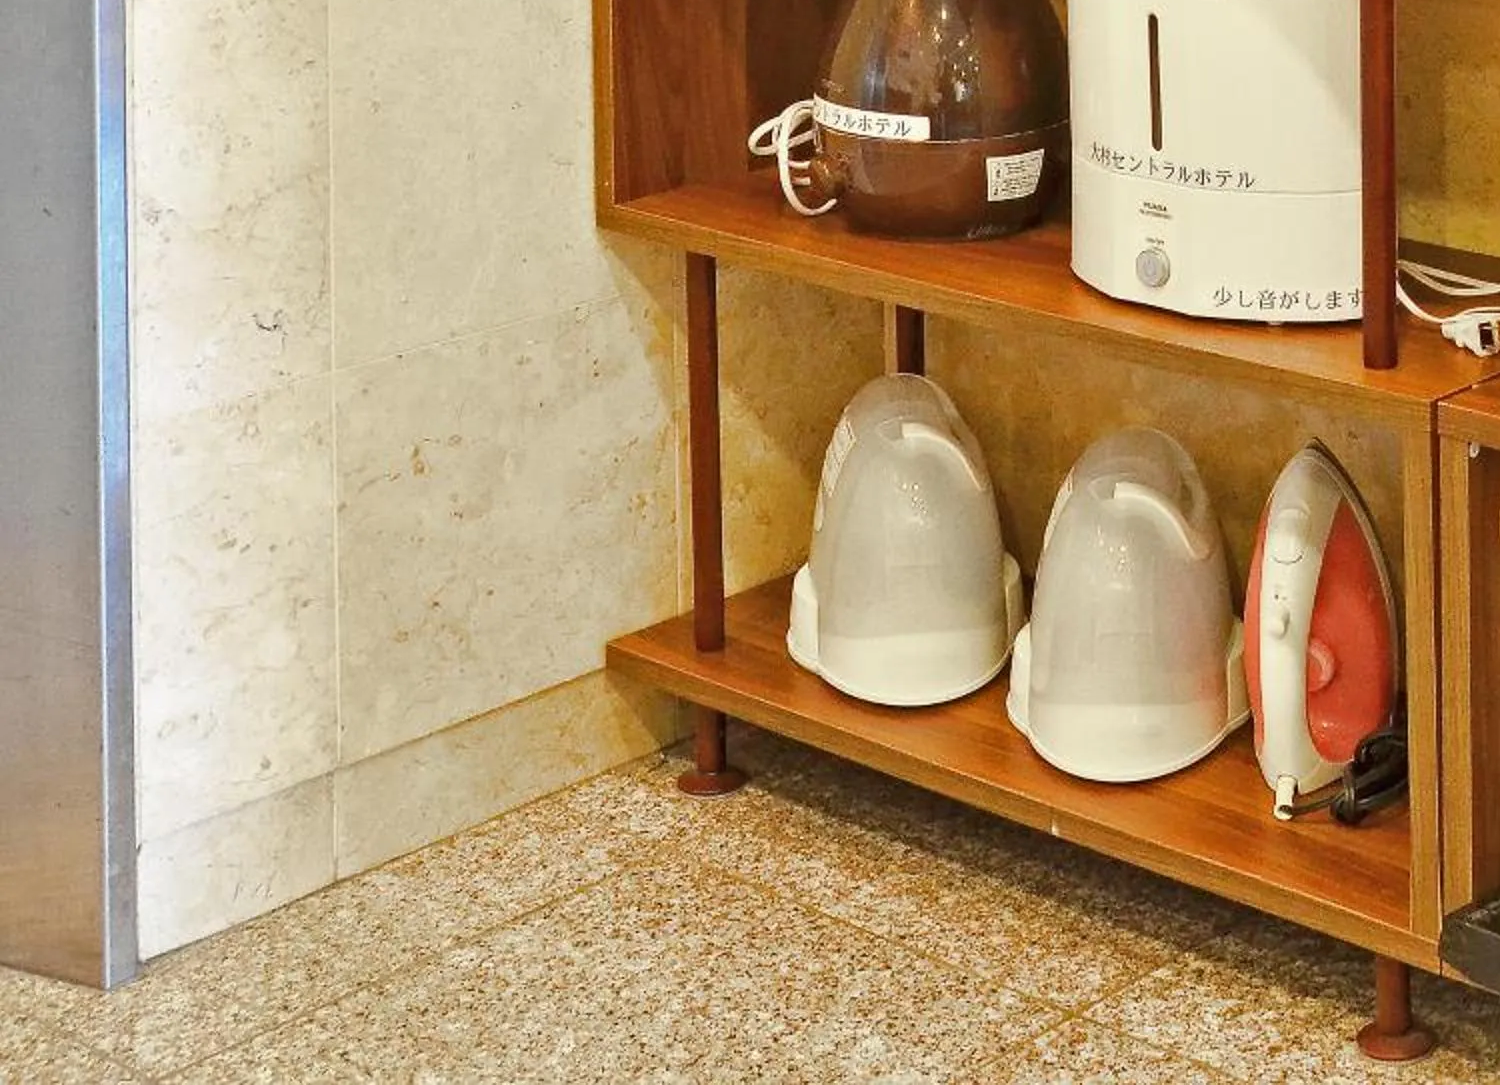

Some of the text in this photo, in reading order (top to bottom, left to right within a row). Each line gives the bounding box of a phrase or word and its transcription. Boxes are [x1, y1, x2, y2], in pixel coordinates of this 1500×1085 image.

[1091, 141, 1256, 188] 大村セントラルホテル
